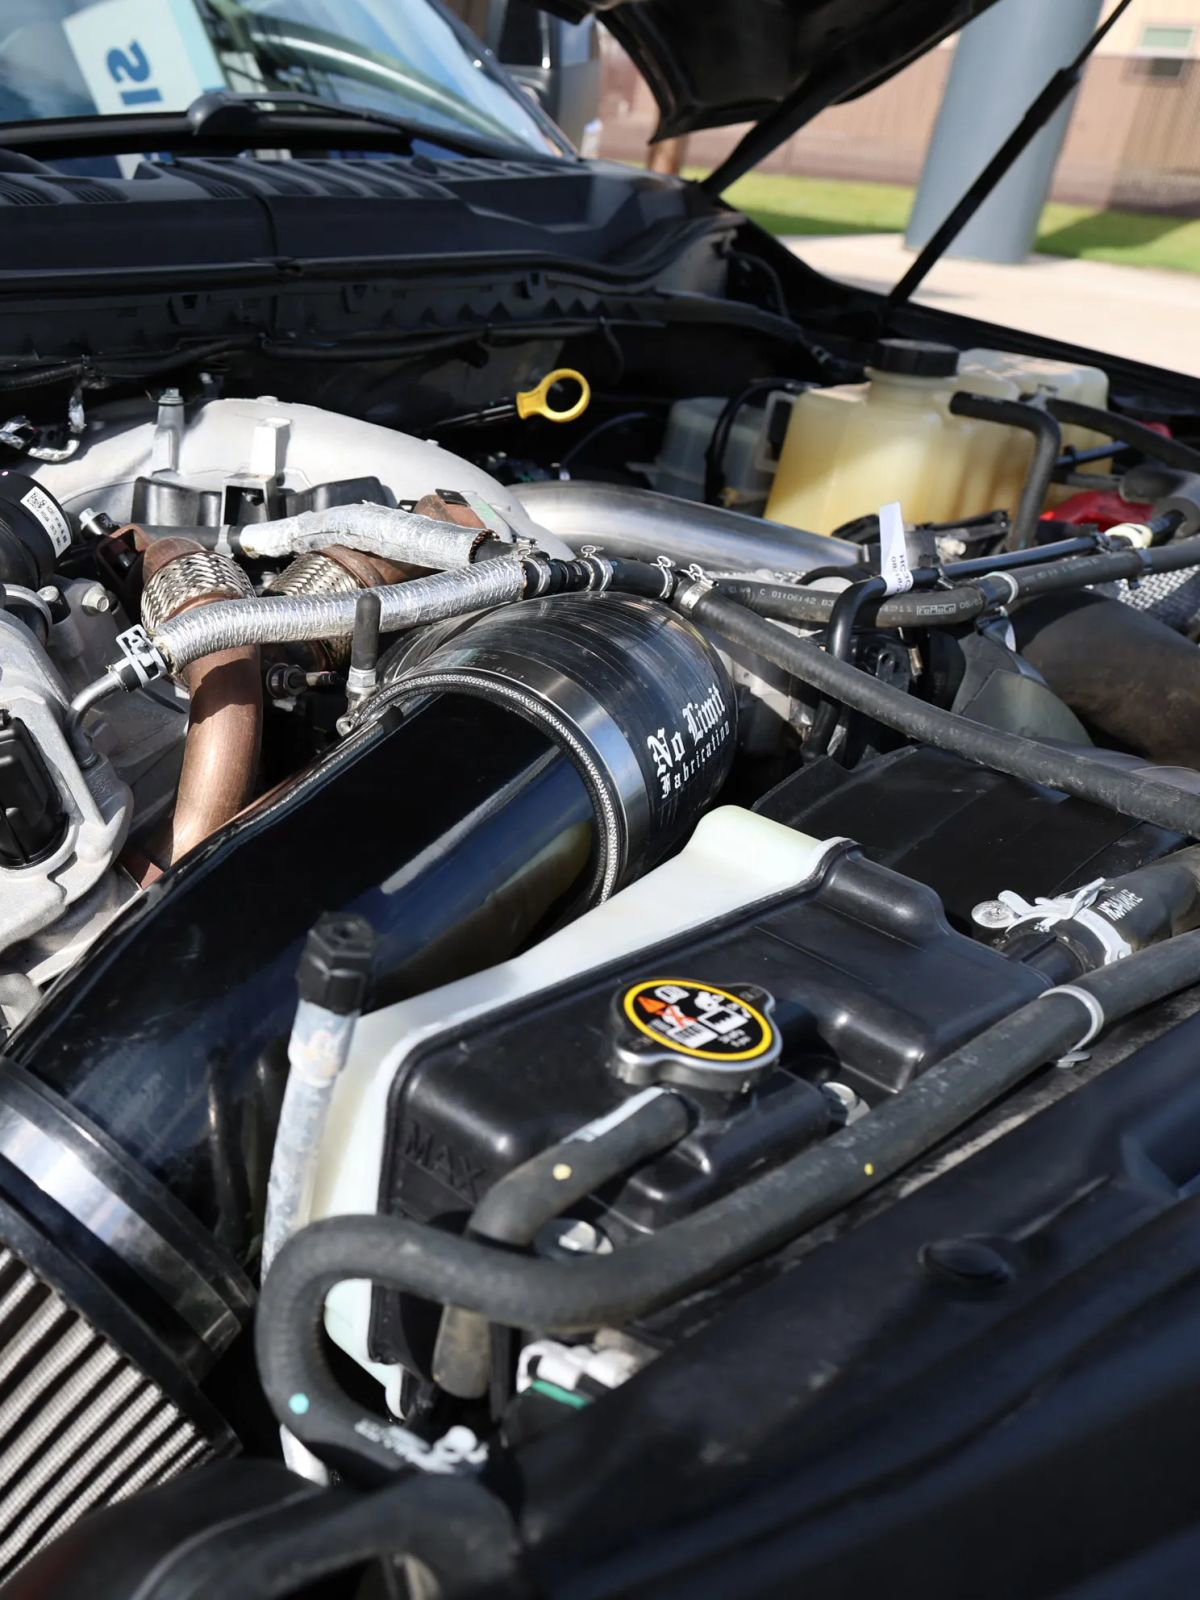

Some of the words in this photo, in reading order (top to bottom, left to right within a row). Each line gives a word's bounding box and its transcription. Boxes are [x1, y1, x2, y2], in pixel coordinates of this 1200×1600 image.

[646, 727, 686, 778] No
[681, 682, 726, 747] Limit
[660, 720, 731, 799] Fabrication
[404, 1120, 488, 1206] MAX
